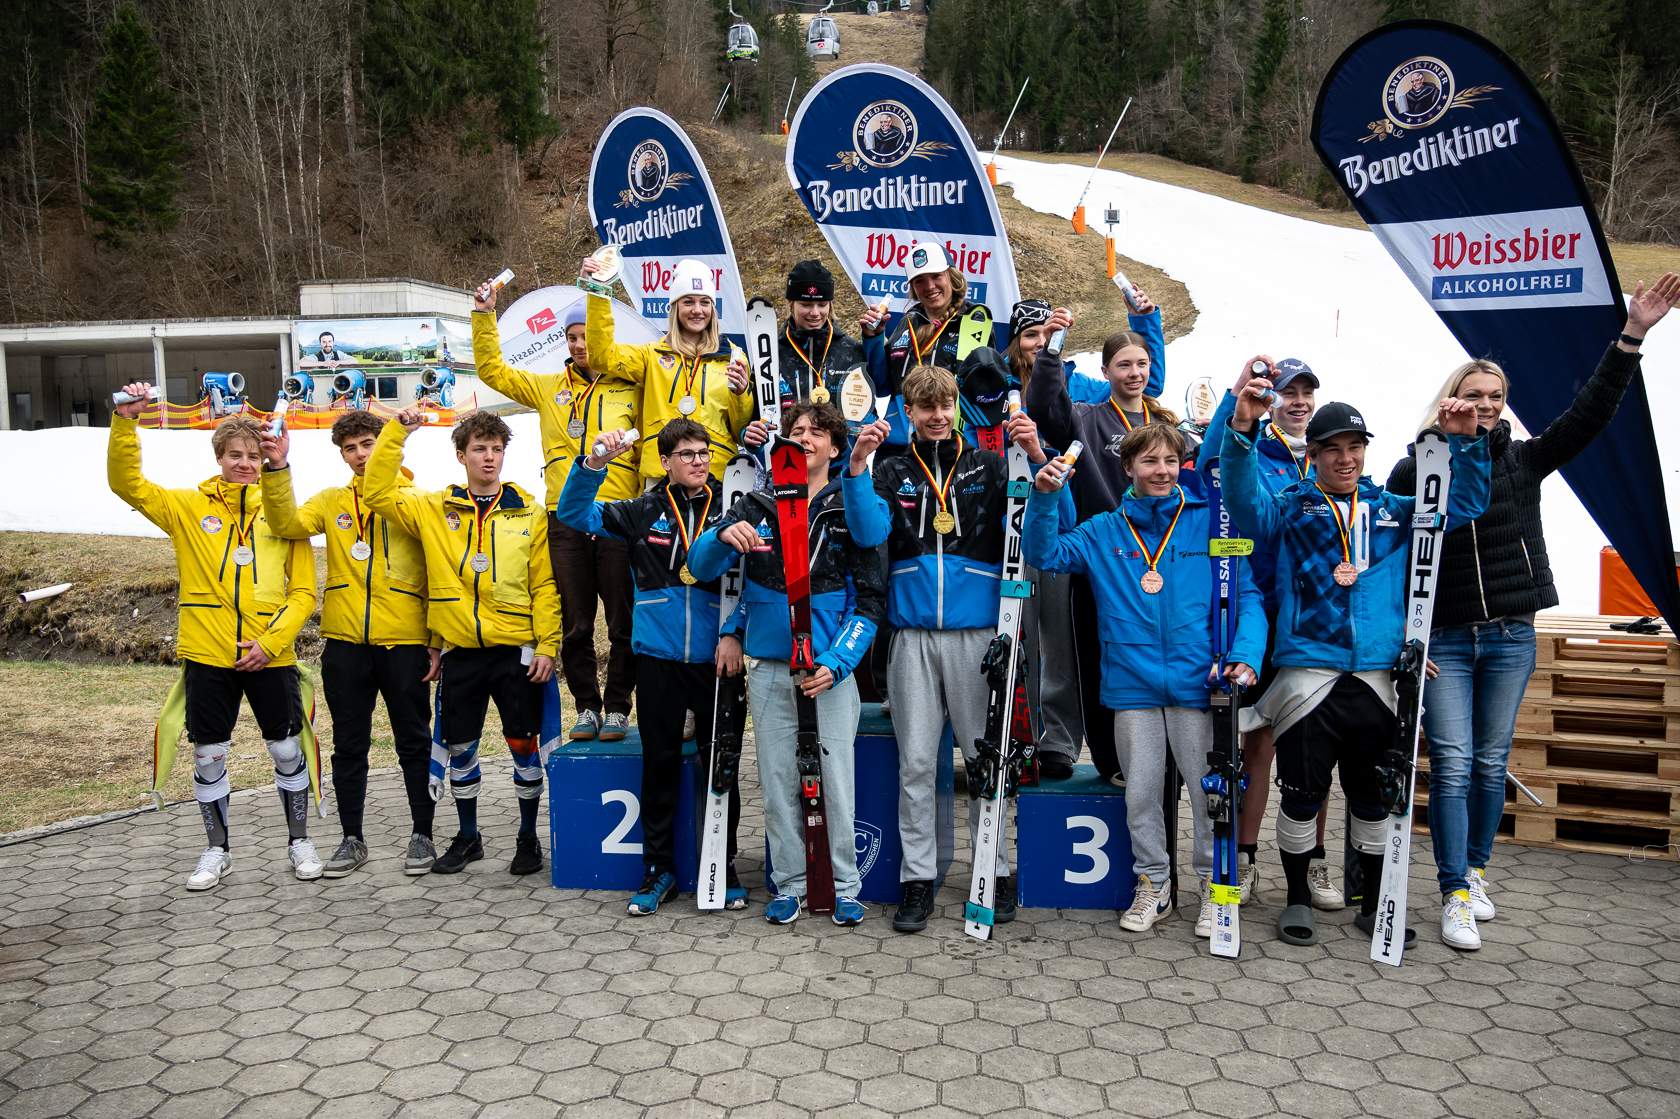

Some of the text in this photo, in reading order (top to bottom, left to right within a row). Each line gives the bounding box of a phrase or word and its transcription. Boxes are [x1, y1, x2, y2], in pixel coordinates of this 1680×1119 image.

[1388, 62, 1448, 102] BENEDIKTINER
[858, 104, 913, 136] BENEDIKTINER
[631, 144, 665, 175] BENEDIKTINER
[1338, 117, 1521, 198] Benediktiner
[807, 174, 968, 222] Benediktiner
[602, 204, 704, 245] Benediktiner
[866, 233, 991, 275] Webier
[1431, 227, 1581, 271] Weissbier
[869, 279, 979, 300] ALKOEI
[1441, 274, 1571, 294] ALKOHOLFREI
[758, 333, 775, 406] EAD
[293, 794, 306, 821] SOCKS
[601, 790, 643, 854] 2
[1064, 815, 1110, 884] 3
[708, 863, 717, 903] HEAD
[1382, 900, 1396, 957] HEAD
